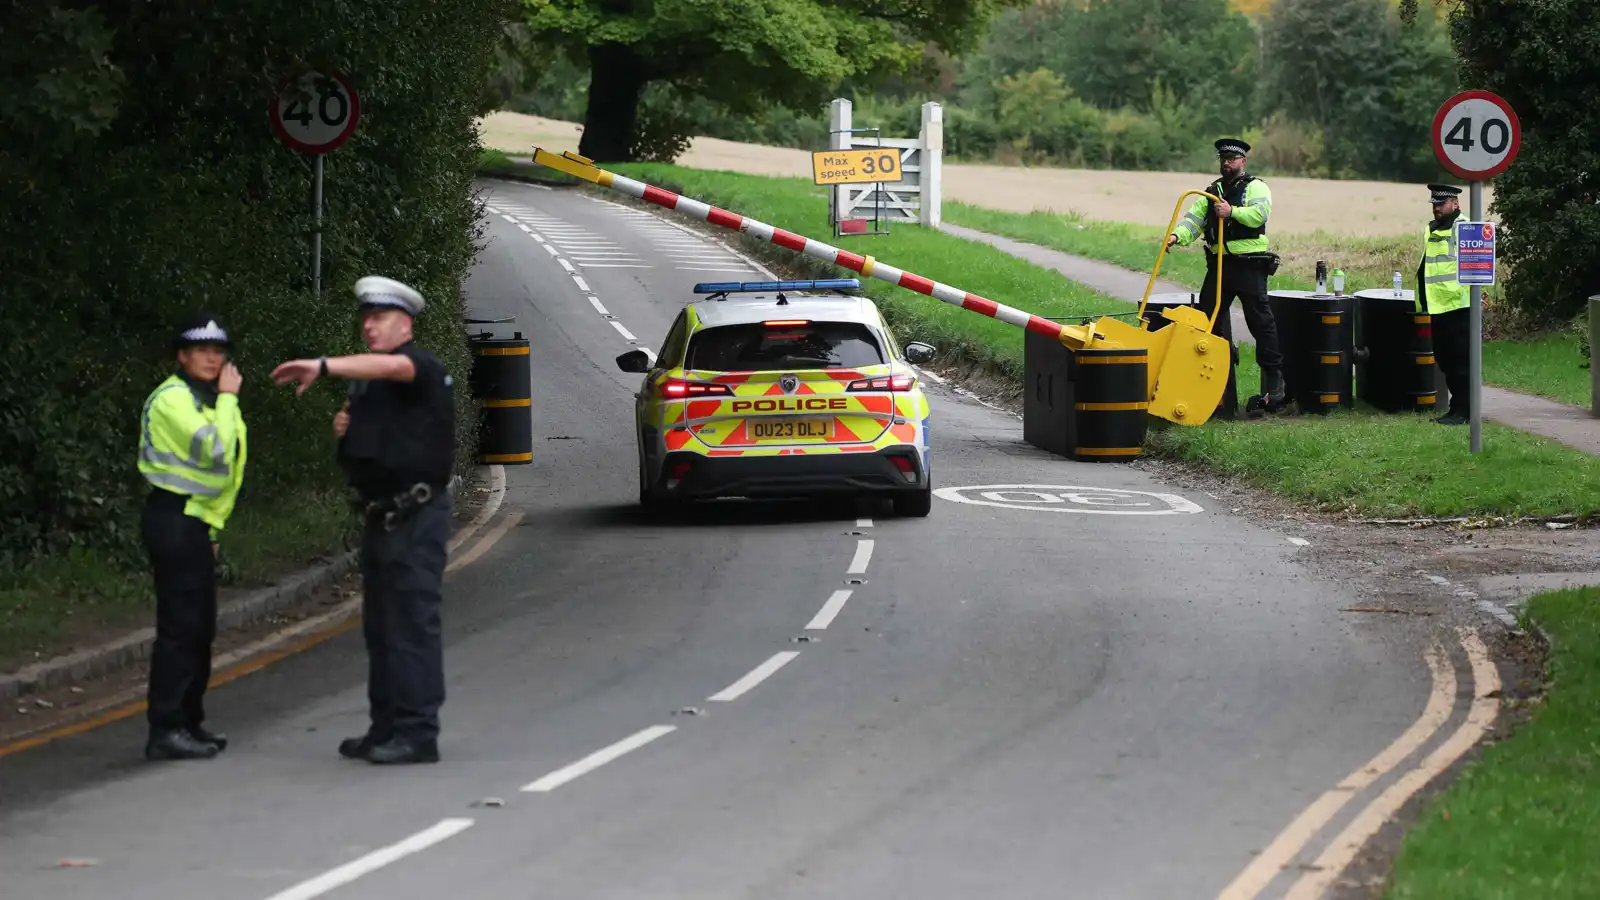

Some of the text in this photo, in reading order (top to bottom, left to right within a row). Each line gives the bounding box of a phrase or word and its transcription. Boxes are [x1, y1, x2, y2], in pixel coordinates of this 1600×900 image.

[282, 89, 347, 127] 40
[1444, 117, 1509, 154] 40
[823, 157, 848, 166] Max
[861, 155, 895, 174] 30
[820, 167, 856, 179] speed
[1460, 240, 1483, 248] STOP
[731, 398, 848, 412] POLICE
[754, 422, 827, 437] OU23 DLJ
